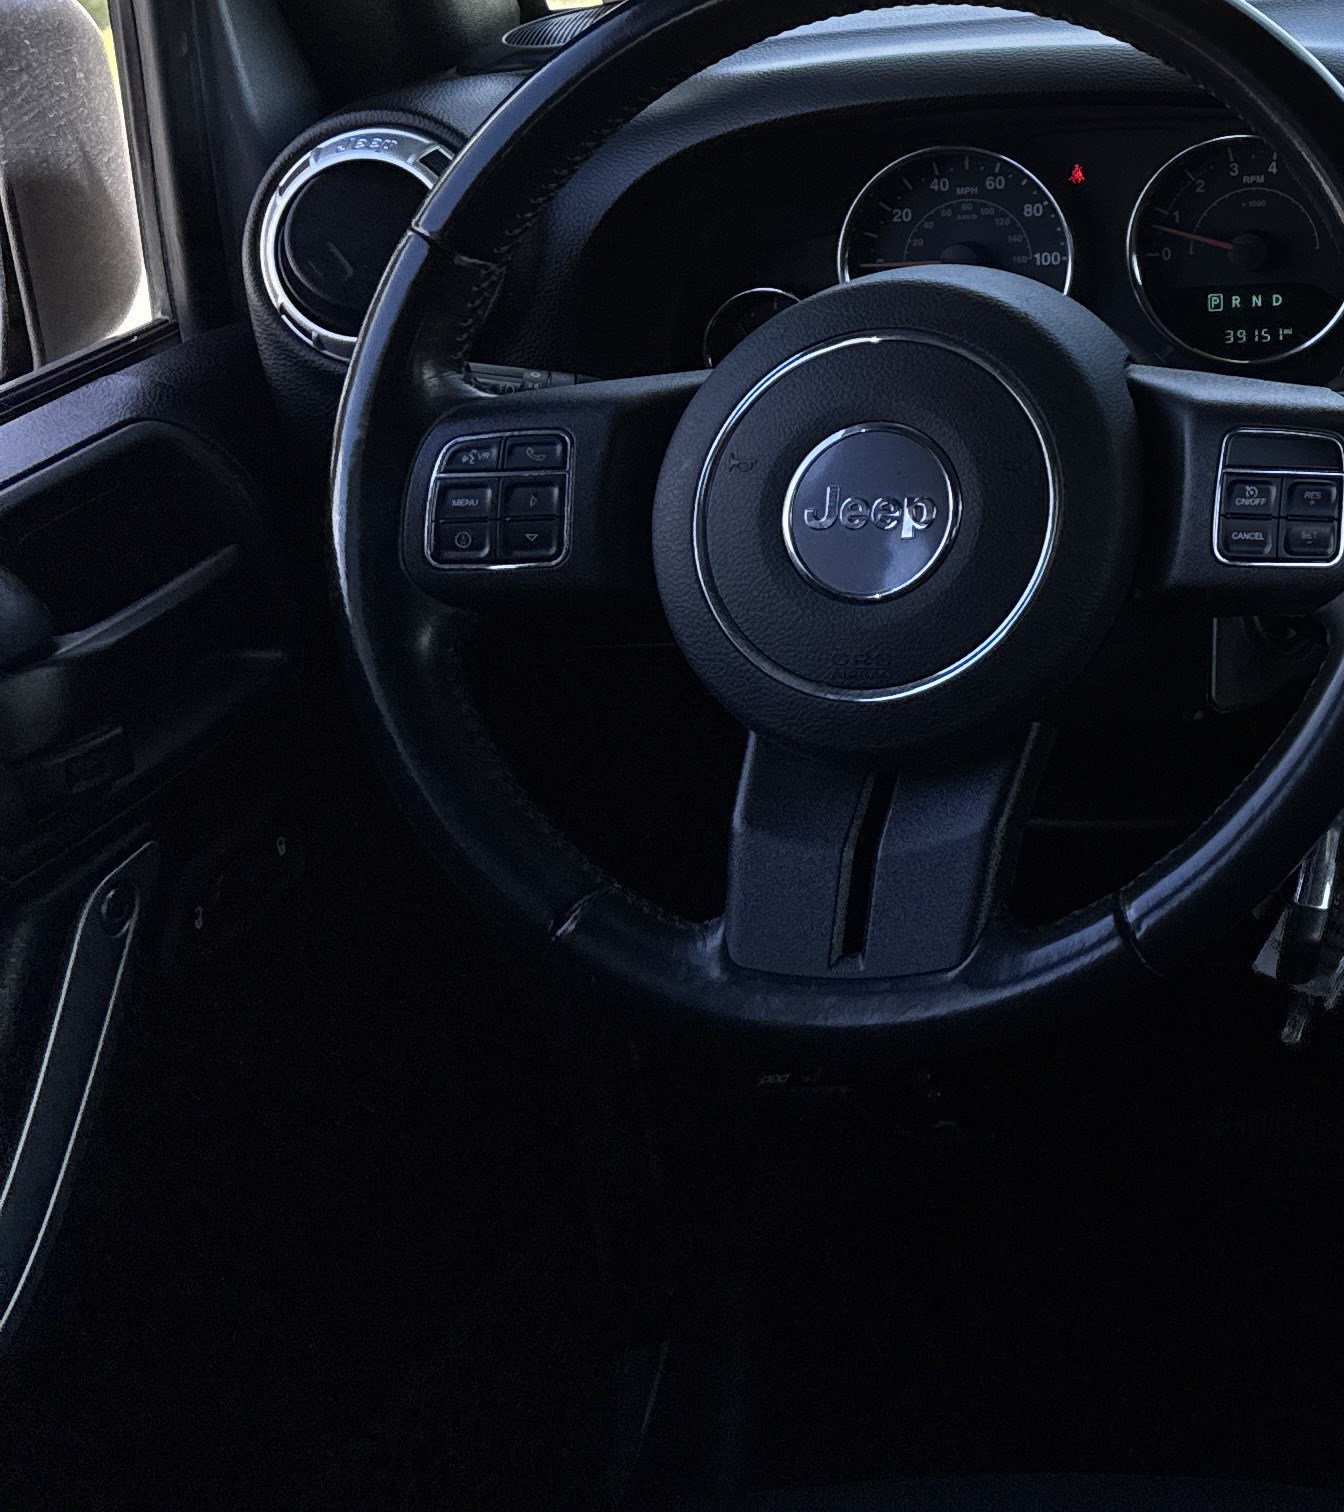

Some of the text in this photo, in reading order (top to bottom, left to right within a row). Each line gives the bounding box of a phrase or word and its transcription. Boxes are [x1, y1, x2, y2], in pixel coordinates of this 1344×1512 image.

[1229, 163, 1239, 176] 3
[1268, 161, 1277, 175] 4
[929, 178, 950, 192] 40
[985, 176, 1005, 190] 60
[1243, 175, 1265, 184] RPM
[956, 187, 978, 196] MPH
[1195, 180, 1205, 193] 2
[892, 208, 912, 222] 20
[1023, 203, 1043, 217] 80
[1173, 210, 1180, 222] 1
[1033, 252, 1061, 266] 100
[1162, 248, 1171, 261] 0
[1210, 293, 1283, 309] P R N D
[451, 498, 479, 507] MENU
[803, 485, 938, 540] Jeep
[1231, 531, 1264, 540] CANCEL
